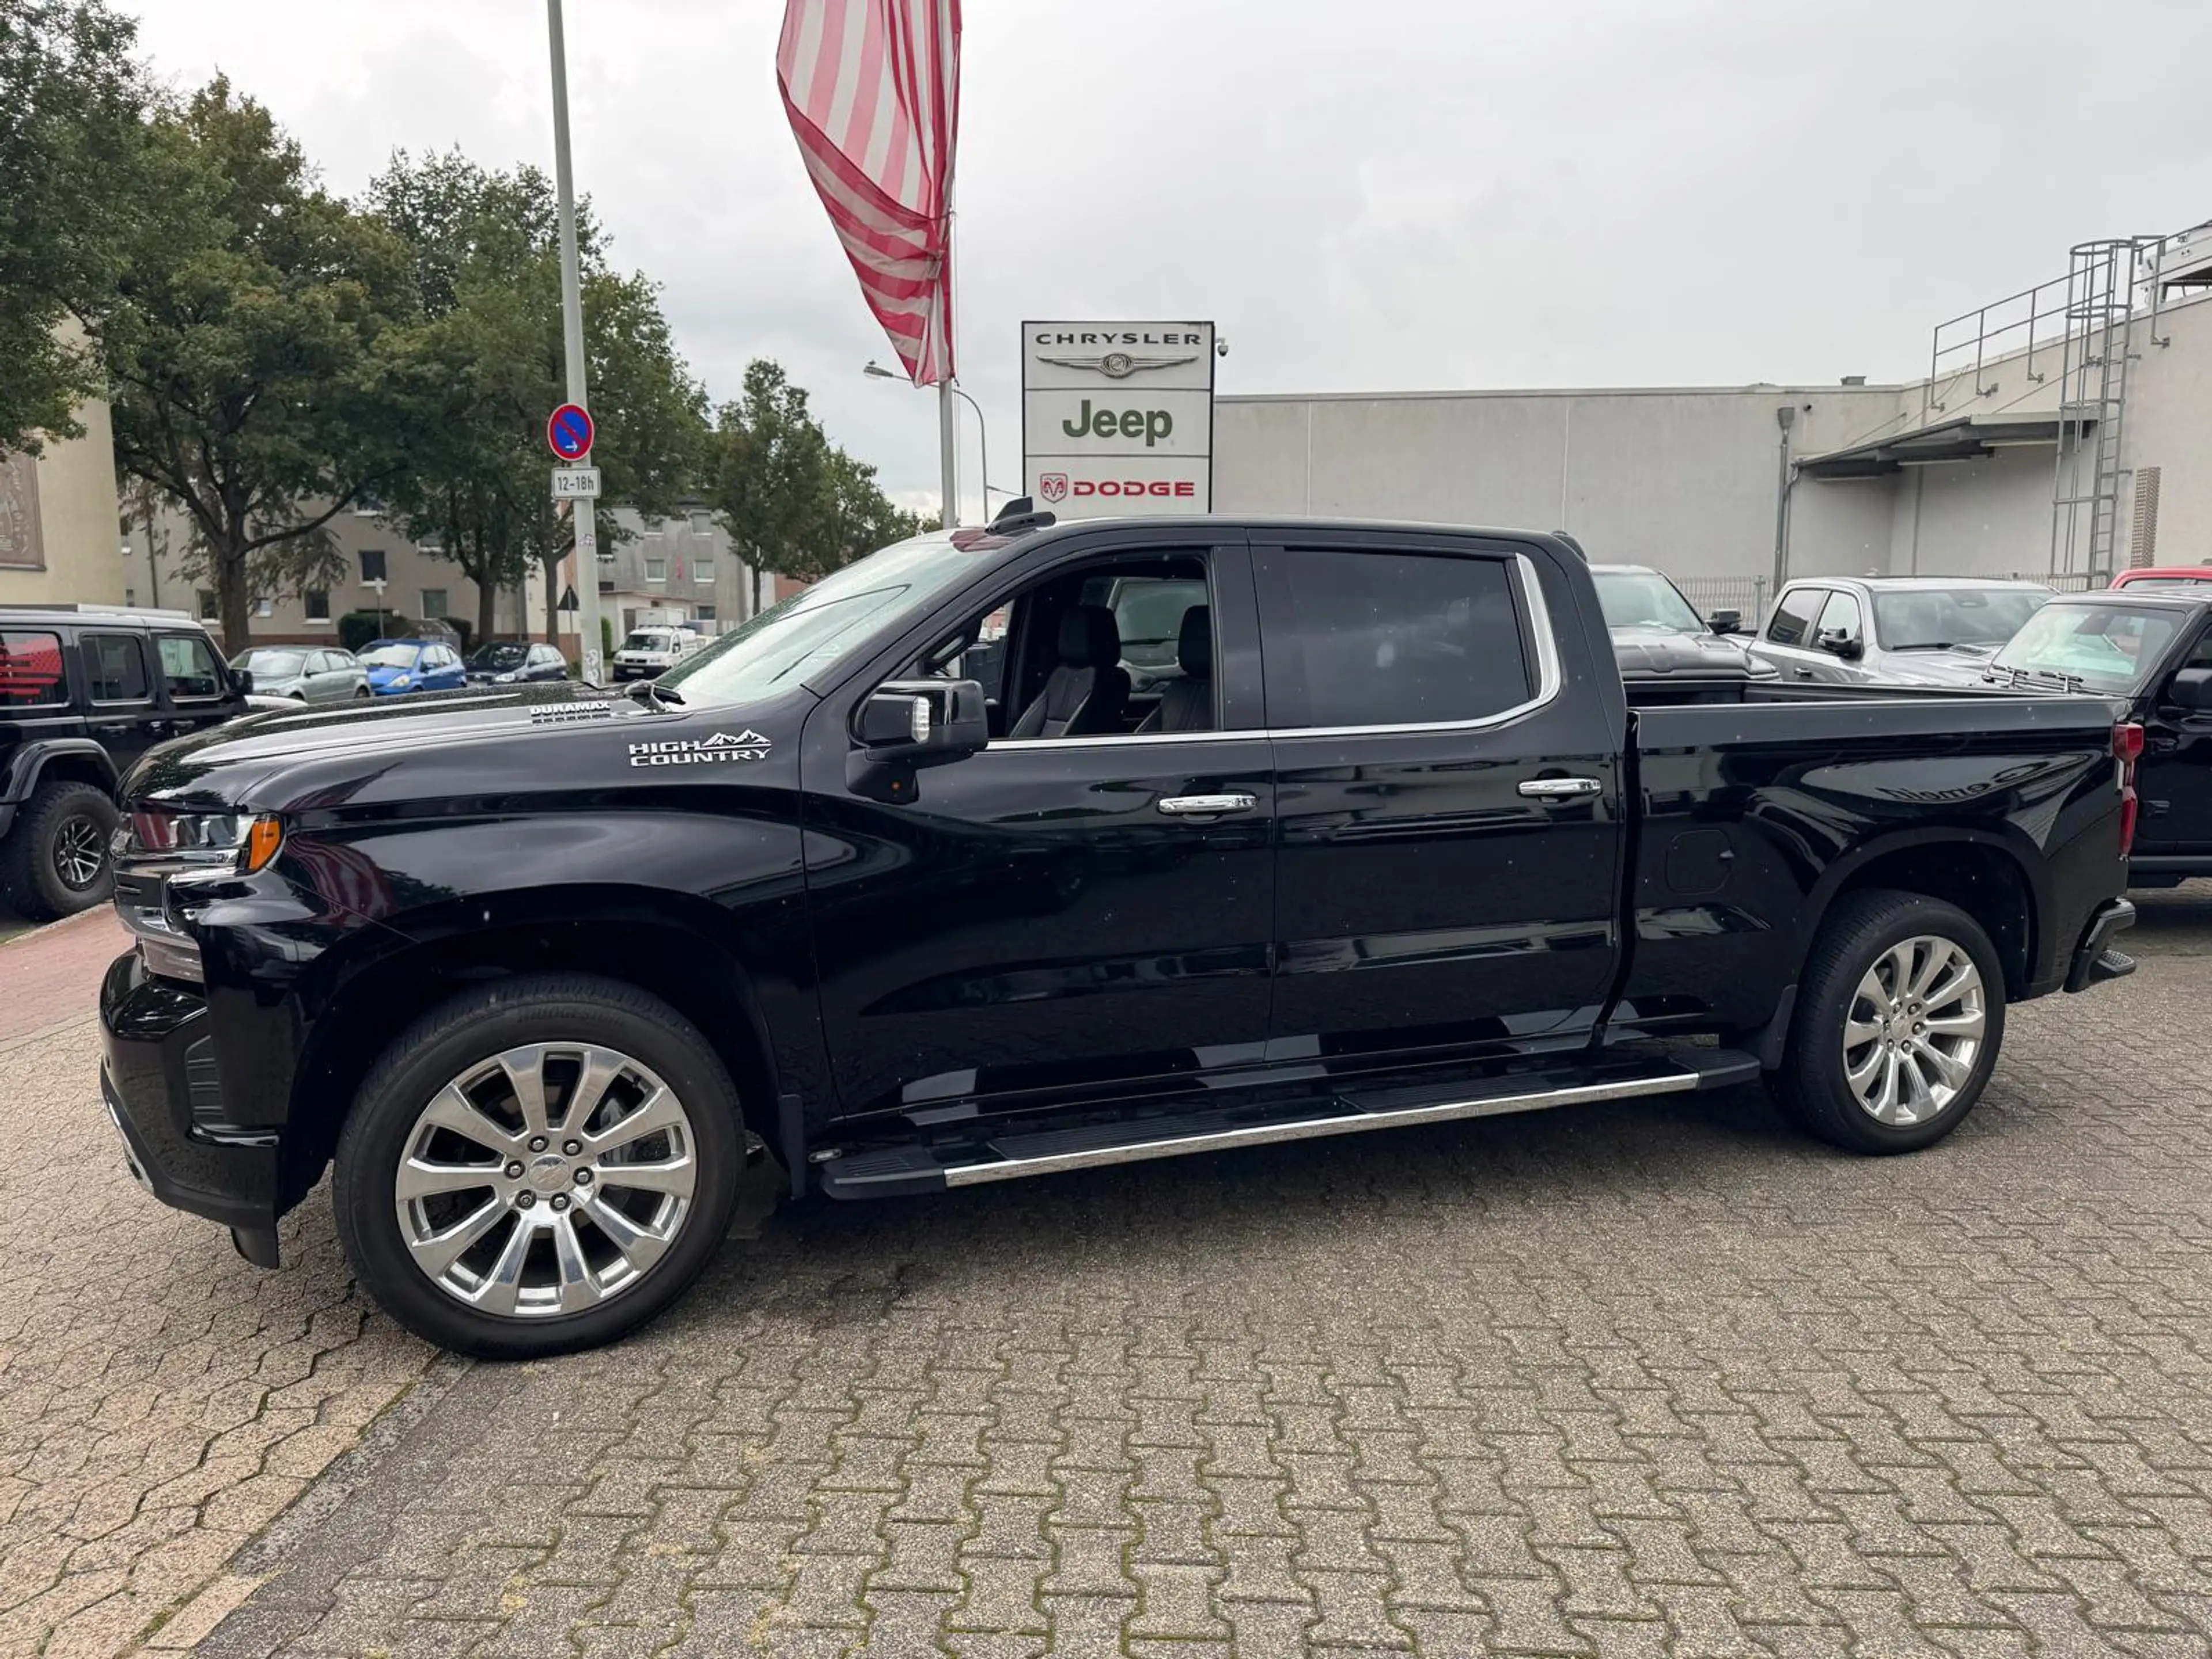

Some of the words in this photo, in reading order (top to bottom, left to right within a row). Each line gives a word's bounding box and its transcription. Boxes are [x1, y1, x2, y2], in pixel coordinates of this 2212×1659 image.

[1036, 333, 1201, 344] CHRYSLER
[1062, 399, 1173, 447] Jeep
[1073, 482, 1195, 496] DODGE
[530, 701, 610, 714] DURAMAX
[628, 740, 700, 755] HIGH
[631, 748, 772, 767] COUNTRY
